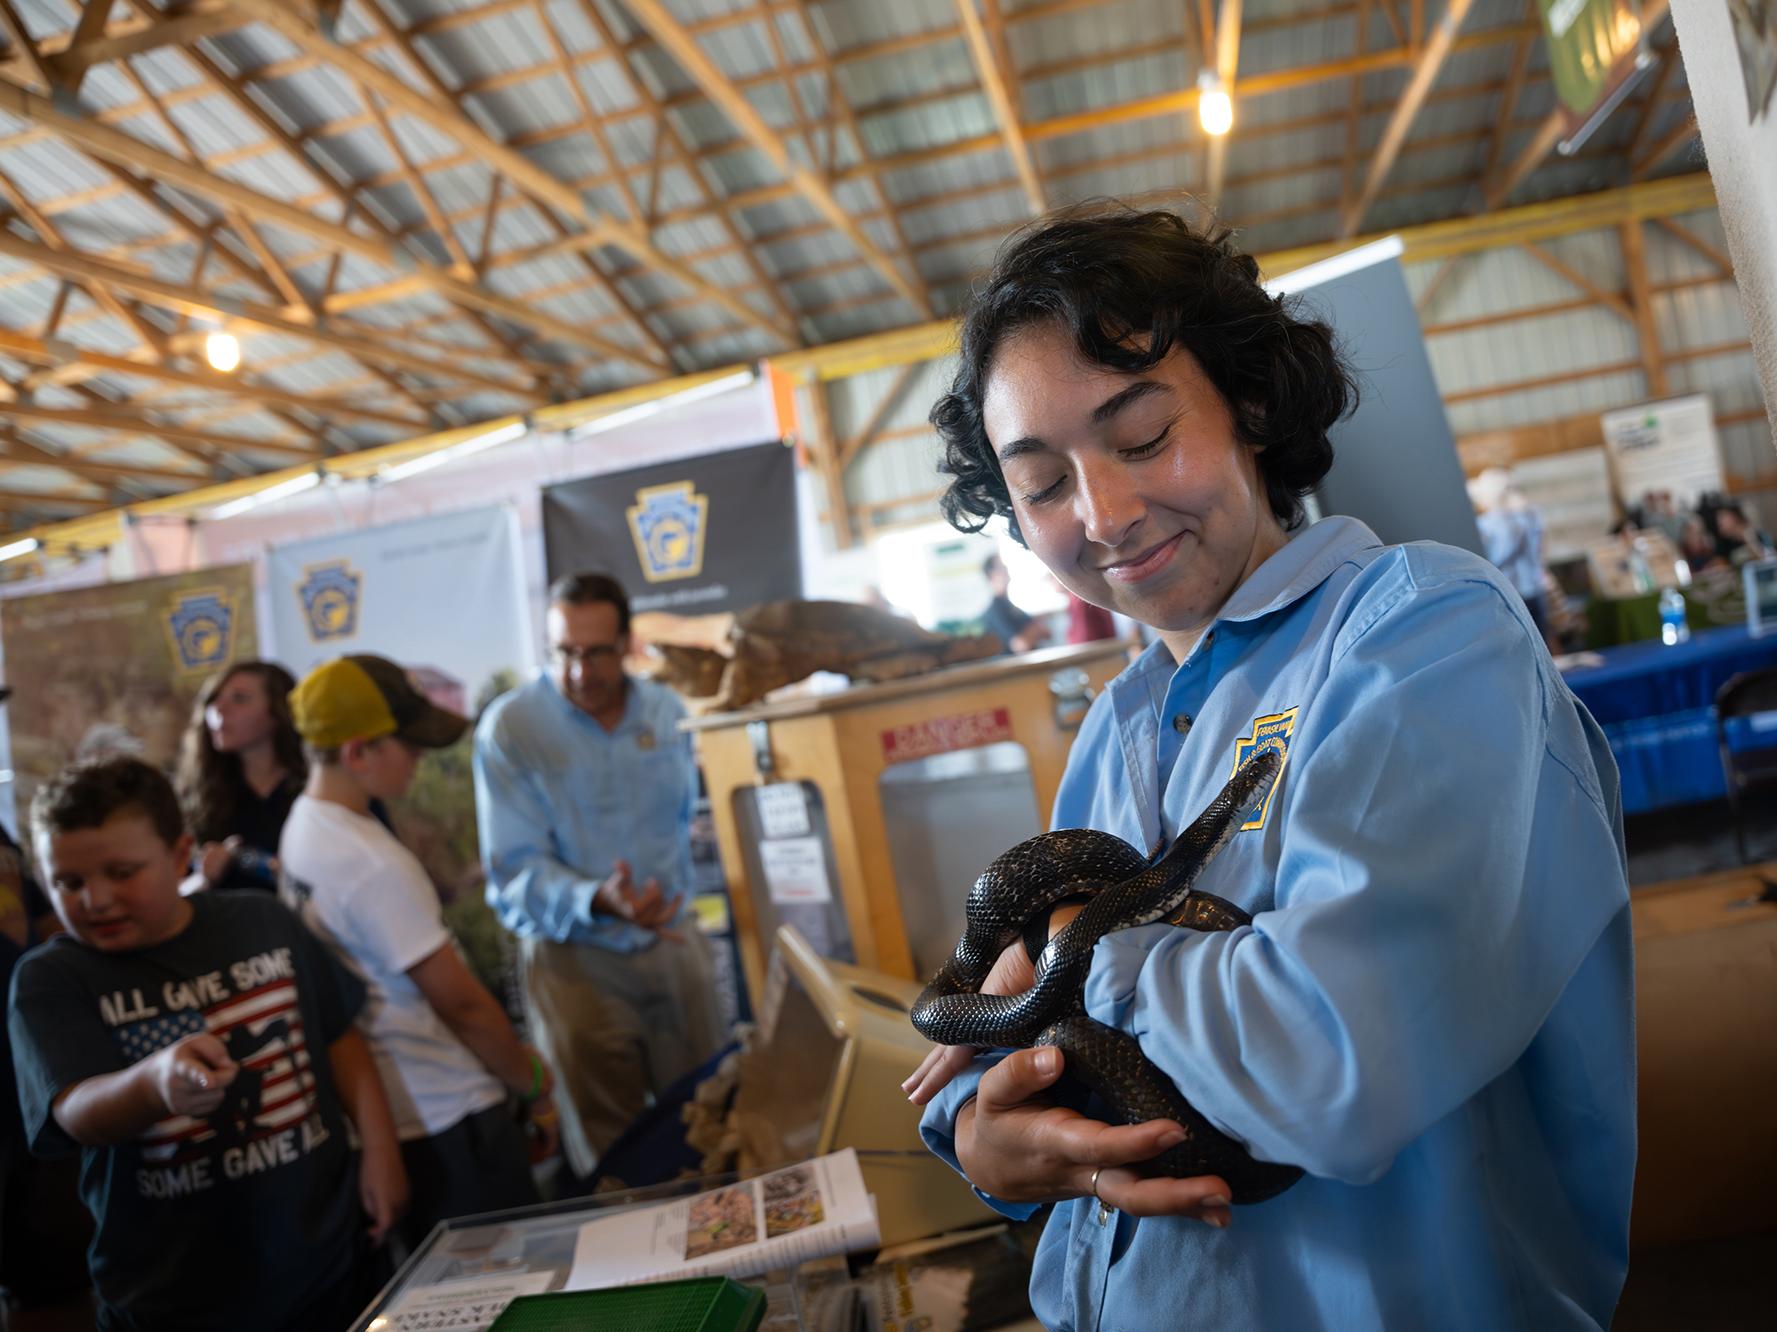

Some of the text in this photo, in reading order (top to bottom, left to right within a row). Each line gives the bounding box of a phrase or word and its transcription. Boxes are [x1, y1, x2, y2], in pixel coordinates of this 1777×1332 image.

[100, 947, 296, 1026] ALL GAVE SOME
[136, 1156, 215, 1199] SOME
[222, 1128, 298, 1179] GAVE
